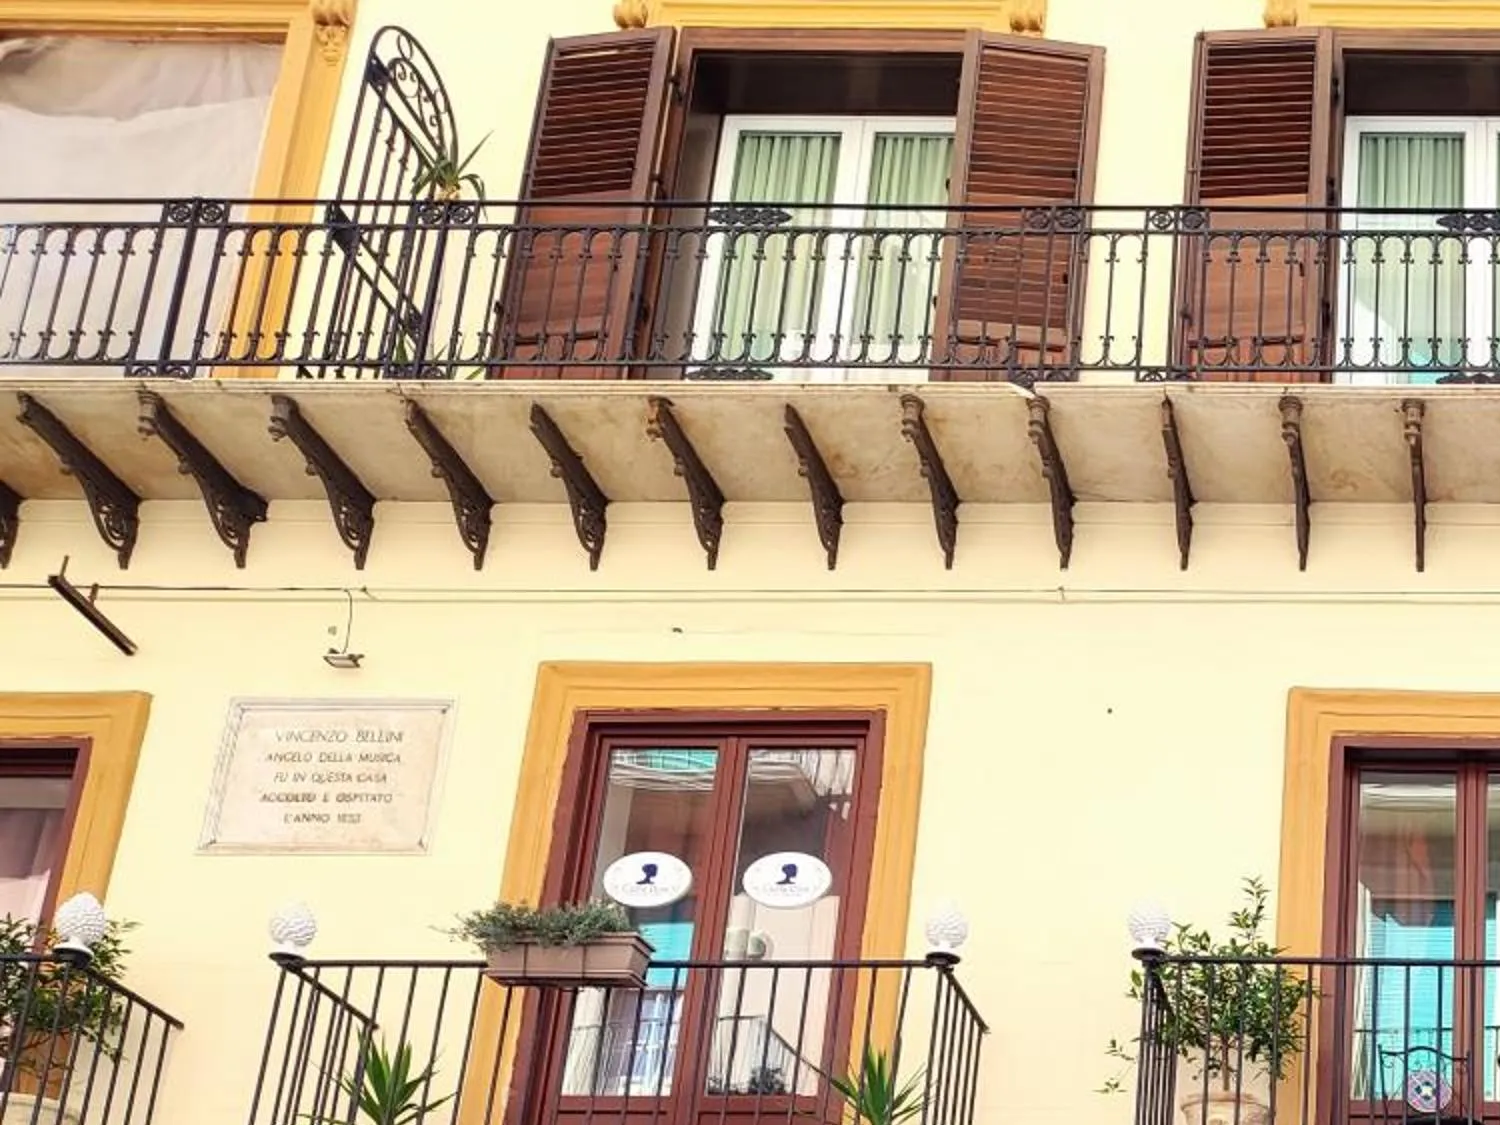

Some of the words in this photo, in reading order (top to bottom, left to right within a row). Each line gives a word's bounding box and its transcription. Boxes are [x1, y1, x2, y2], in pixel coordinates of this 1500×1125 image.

[275, 730, 348, 743] VINCENZO
[355, 729, 404, 743] BELLINI
[265, 752, 313, 763] ANGELO
[318, 752, 353, 763] DELLA
[358, 752, 401, 763] MUSICA
[274, 772, 287, 783] FU
[292, 772, 306, 783] IN
[311, 772, 353, 784] QUESTA
[356, 772, 388, 783] CASA
[335, 792, 393, 803] OSPITATO
